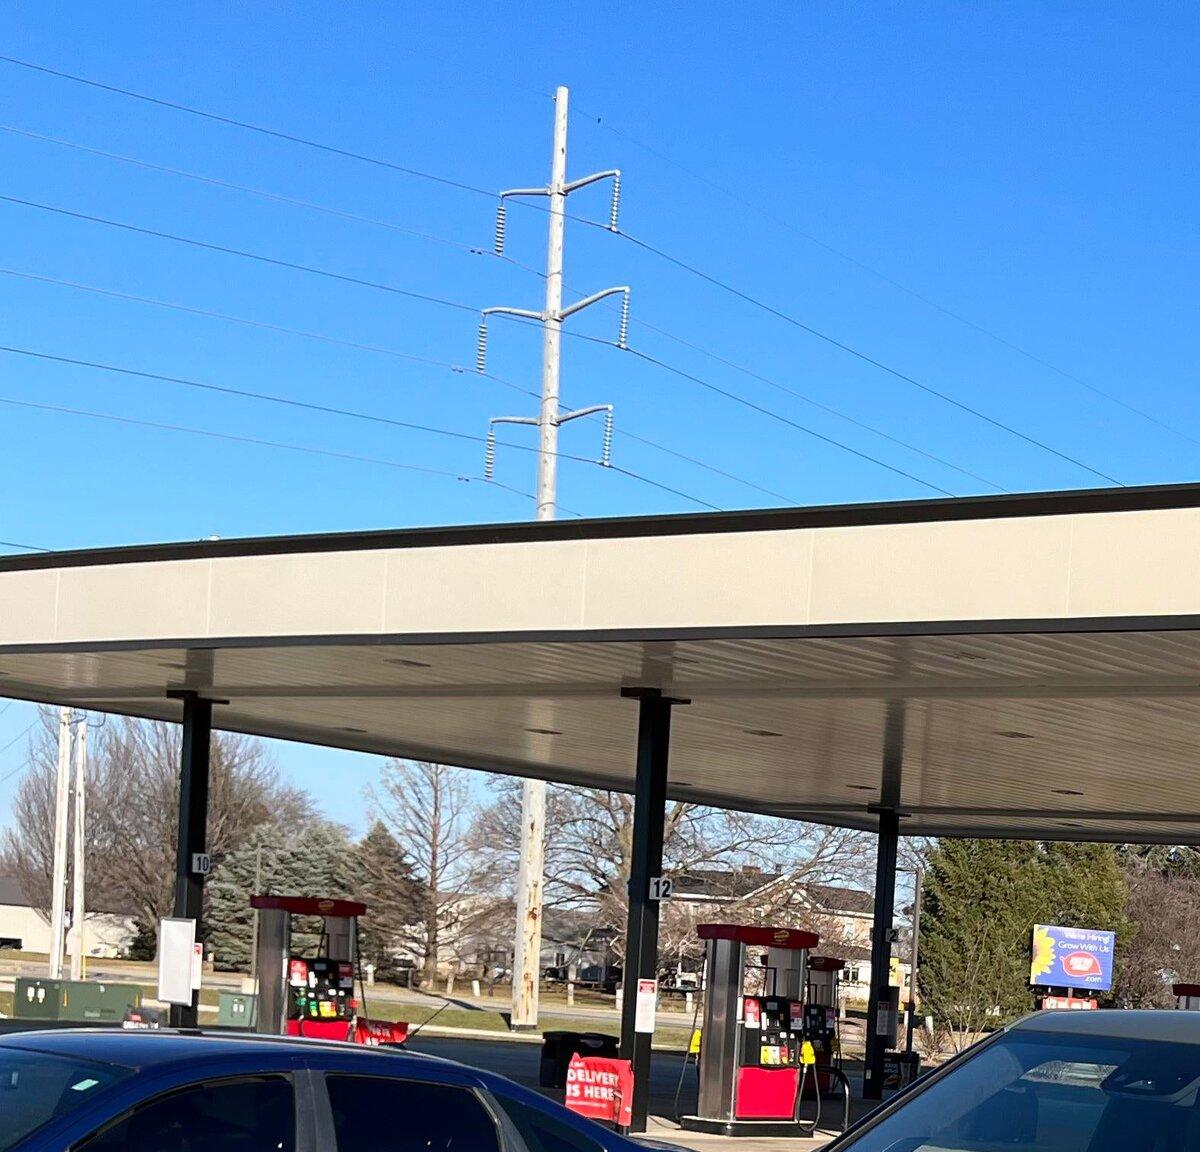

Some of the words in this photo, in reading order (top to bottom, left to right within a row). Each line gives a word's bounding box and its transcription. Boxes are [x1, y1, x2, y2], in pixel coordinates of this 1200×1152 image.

[196, 856, 209, 871] 10
[653, 879, 671, 898] 12
[1058, 941, 1079, 949] Grow
[1079, 943, 1098, 952] With
[567, 1068, 620, 1087] DELIVERY
[566, 1083, 580, 1097] IS
[584, 1085, 615, 1101] HERE
